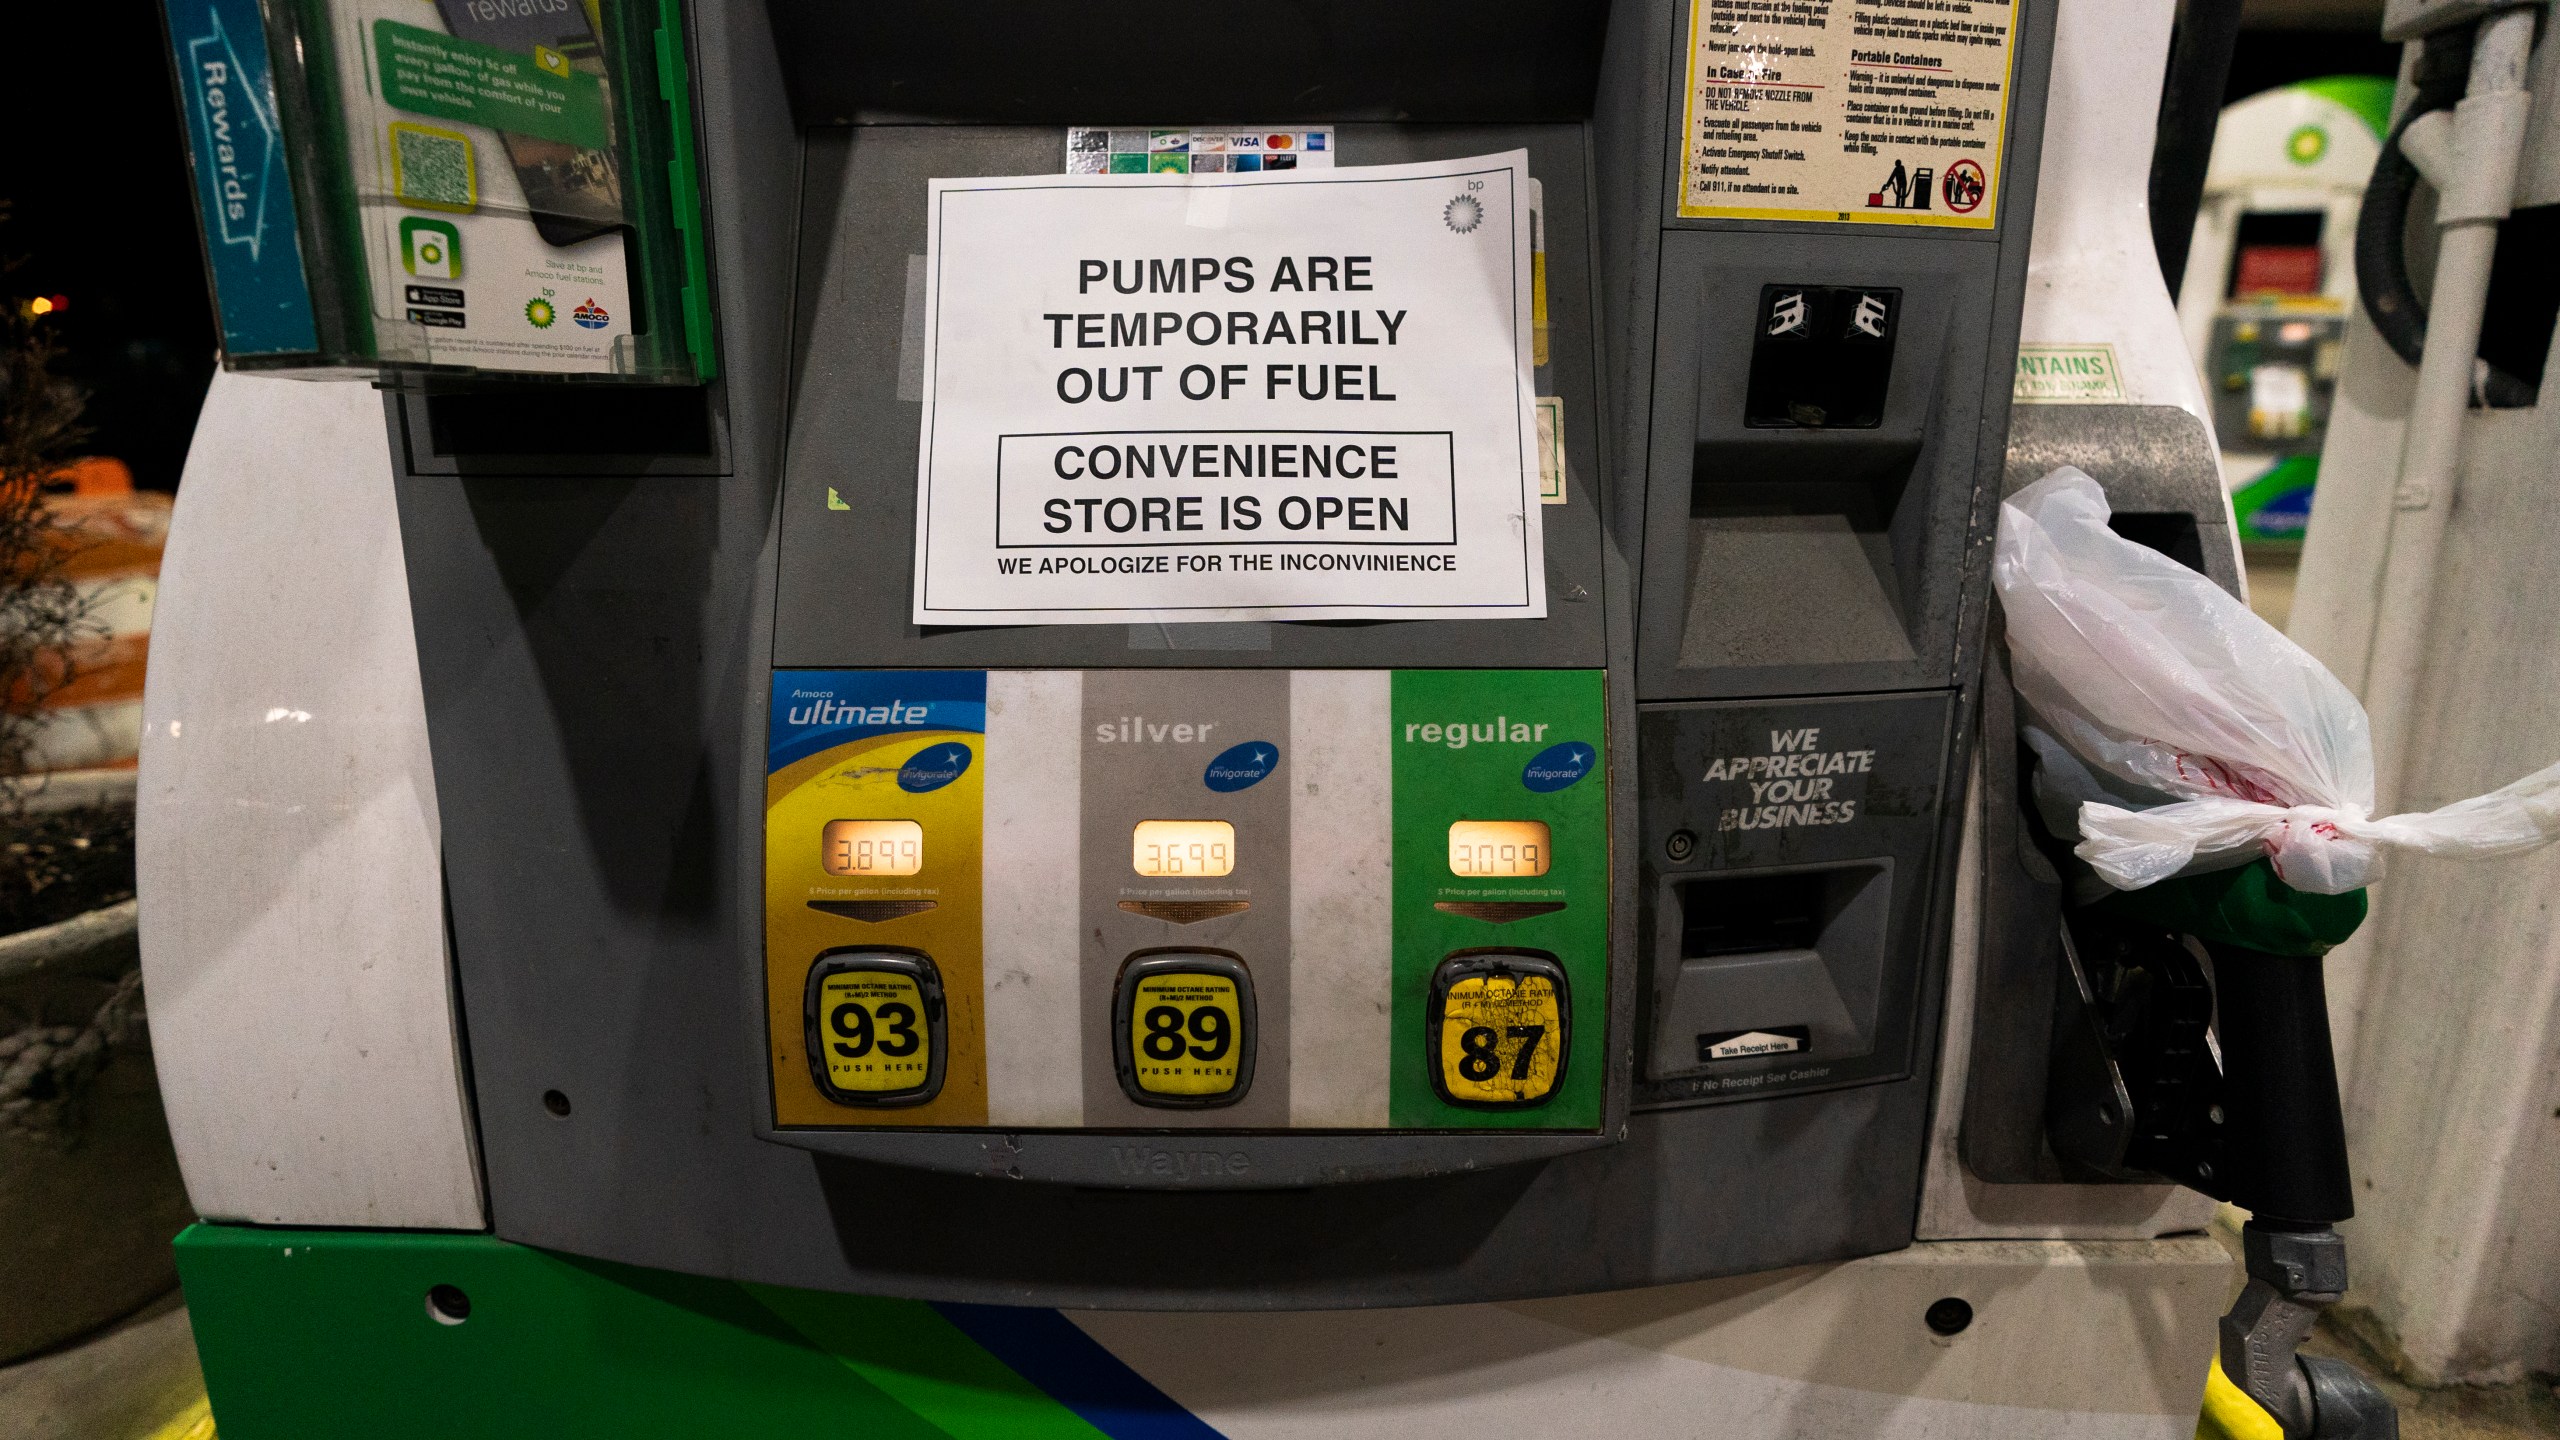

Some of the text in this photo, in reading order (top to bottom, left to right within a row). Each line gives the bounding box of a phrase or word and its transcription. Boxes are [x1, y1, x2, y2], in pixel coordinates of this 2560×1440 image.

[1851, 49, 1942, 68] Portable Containers
[1707, 66, 1716, 78] In
[1720, 67, 1744, 79] Case
[1762, 69, 1782, 80] Fire
[1706, 87, 1812, 102] DO NOT REMOVE NOZZLE FROM
[1706, 99, 1750, 112] THE VEHICLE.
[1704, 116, 1730, 128] Evacuate
[1741, 120, 1774, 132] passengers
[1776, 120, 1788, 130] from
[1790, 120, 1799, 132] the
[1801, 121, 1822, 132] vehicle
[203, 61, 248, 221] Rewards
[1232, 137, 1259, 146] VISA
[1703, 129, 1758, 143] and refueling area.
[1702, 146, 1806, 161] Activate Emergency Shutoff Switch.
[1701, 164, 1750, 176] Notify attendant.
[1468, 180, 1484, 192] bp
[1700, 181, 1711, 192] Call
[1713, 181, 1726, 192] 911,
[1728, 182, 1732, 192] if
[1734, 184, 1740, 192] no
[1742, 183, 1770, 194] attendant
[1772, 184, 1776, 193] is
[1778, 186, 1785, 194] on
[525, 269, 554, 279] Amoco
[556, 272, 570, 281] fuel
[546, 259, 603, 274] Save at bp and
[1080, 256, 1373, 294] PUMPS ARE
[542, 286, 555, 298] bp
[573, 312, 610, 322] AMOCO
[1044, 310, 1407, 348] TEMPORARILY
[2016, 356, 2105, 375] NTAINS
[1057, 365, 1397, 403] OUT OF FUEL
[1054, 444, 1398, 480] CONVENIENCE
[1043, 496, 1409, 534] STORE IS OPEN
[998, 554, 1456, 575] WE APOLOGIZE FOR THE INCONVINIENCE
[792, 689, 834, 698] Amoco
[788, 699, 928, 725] ultimate
[1096, 716, 1213, 743] silver
[1406, 716, 1548, 749] regular
[1771, 728, 1820, 752] WE
[1702, 750, 1876, 782] APPRECIATE
[1750, 778, 1834, 804] YOUR
[1718, 800, 1856, 832] BUSINESS
[838, 840, 916, 870] 3.899
[1148, 843, 1226, 874] 3.699
[838, 888, 852, 896] per
[854, 887, 879, 896] gallon
[881, 887, 920, 896] (including
[1165, 888, 1190, 896] gallon
[1192, 888, 1233, 896] (including
[1235, 888, 1252, 896] tax)
[1482, 888, 1507, 897] gallon
[1509, 888, 1548, 897] (including
[1550, 888, 1566, 896] tax)
[1486, 988, 1526, 999] OCTANE
[830, 1002, 920, 1058] 93
[1143, 1005, 1231, 1062] 89
[1458, 1025, 1545, 1082] 87
[1720, 1042, 1789, 1056] Take Receipt Here
[833, 1064, 873, 1072] PUSH
[1703, 1080, 1719, 1090] No
[1722, 1075, 1764, 1088] Receipt
[1766, 1073, 1787, 1083] See
[1789, 1067, 1830, 1080] Cashier
[1110, 1146, 1250, 1182] Wayne
